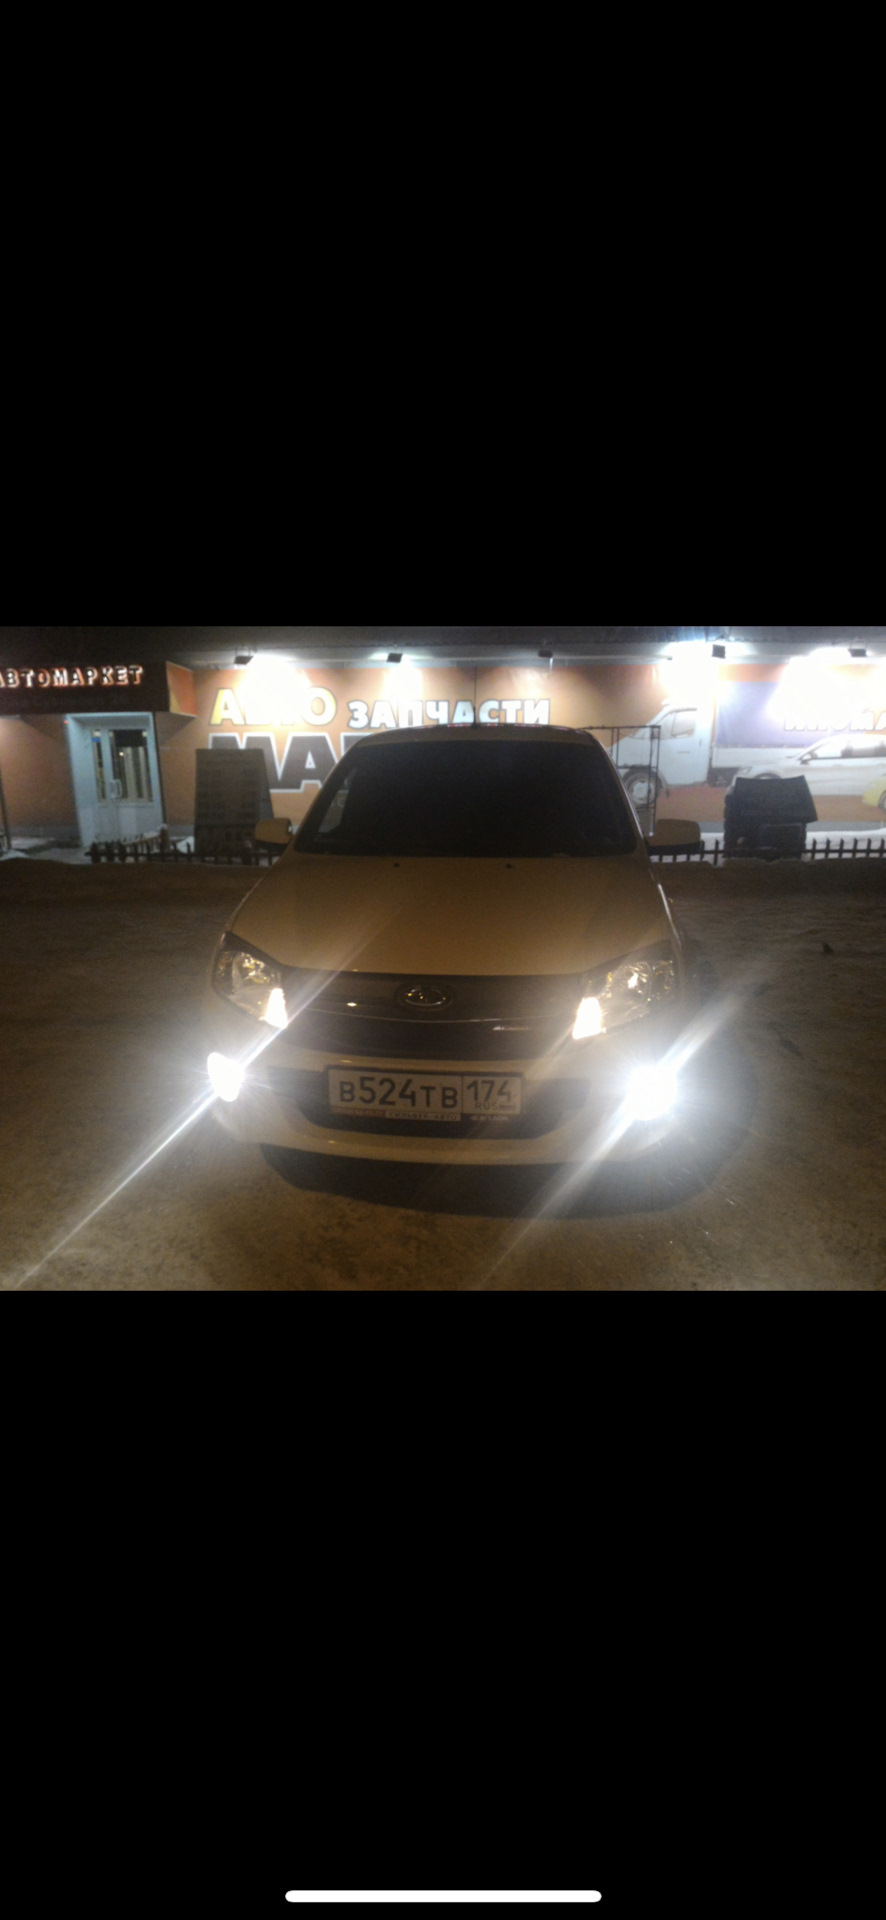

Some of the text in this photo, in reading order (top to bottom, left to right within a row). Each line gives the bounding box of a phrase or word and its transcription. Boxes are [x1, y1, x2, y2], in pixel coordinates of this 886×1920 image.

[213, 688, 551, 728] АО ЗАПЧАСТИ
[208, 732, 376, 794] МА
[339, 1076, 513, 1109] В524ТВ 174
